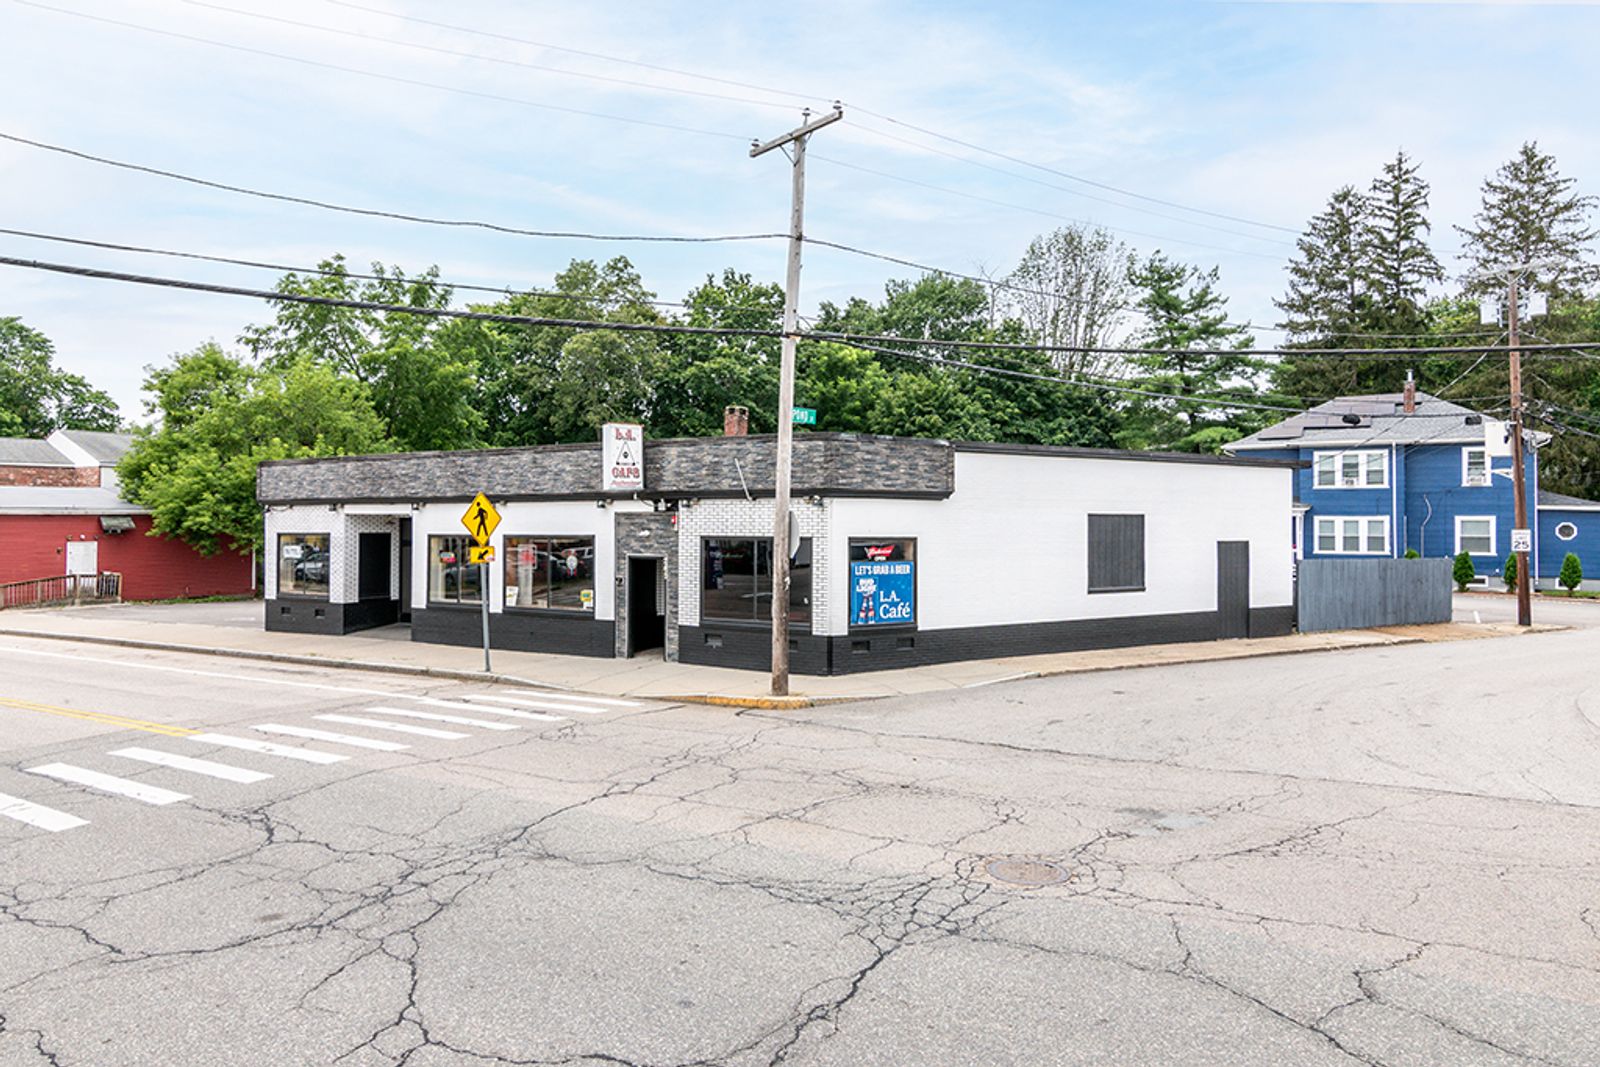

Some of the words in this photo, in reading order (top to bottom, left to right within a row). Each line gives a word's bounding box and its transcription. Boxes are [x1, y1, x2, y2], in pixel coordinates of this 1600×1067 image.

[1514, 540, 1530, 549] 25
[855, 565, 872, 576] LET'S
[879, 602, 911, 619] Café
